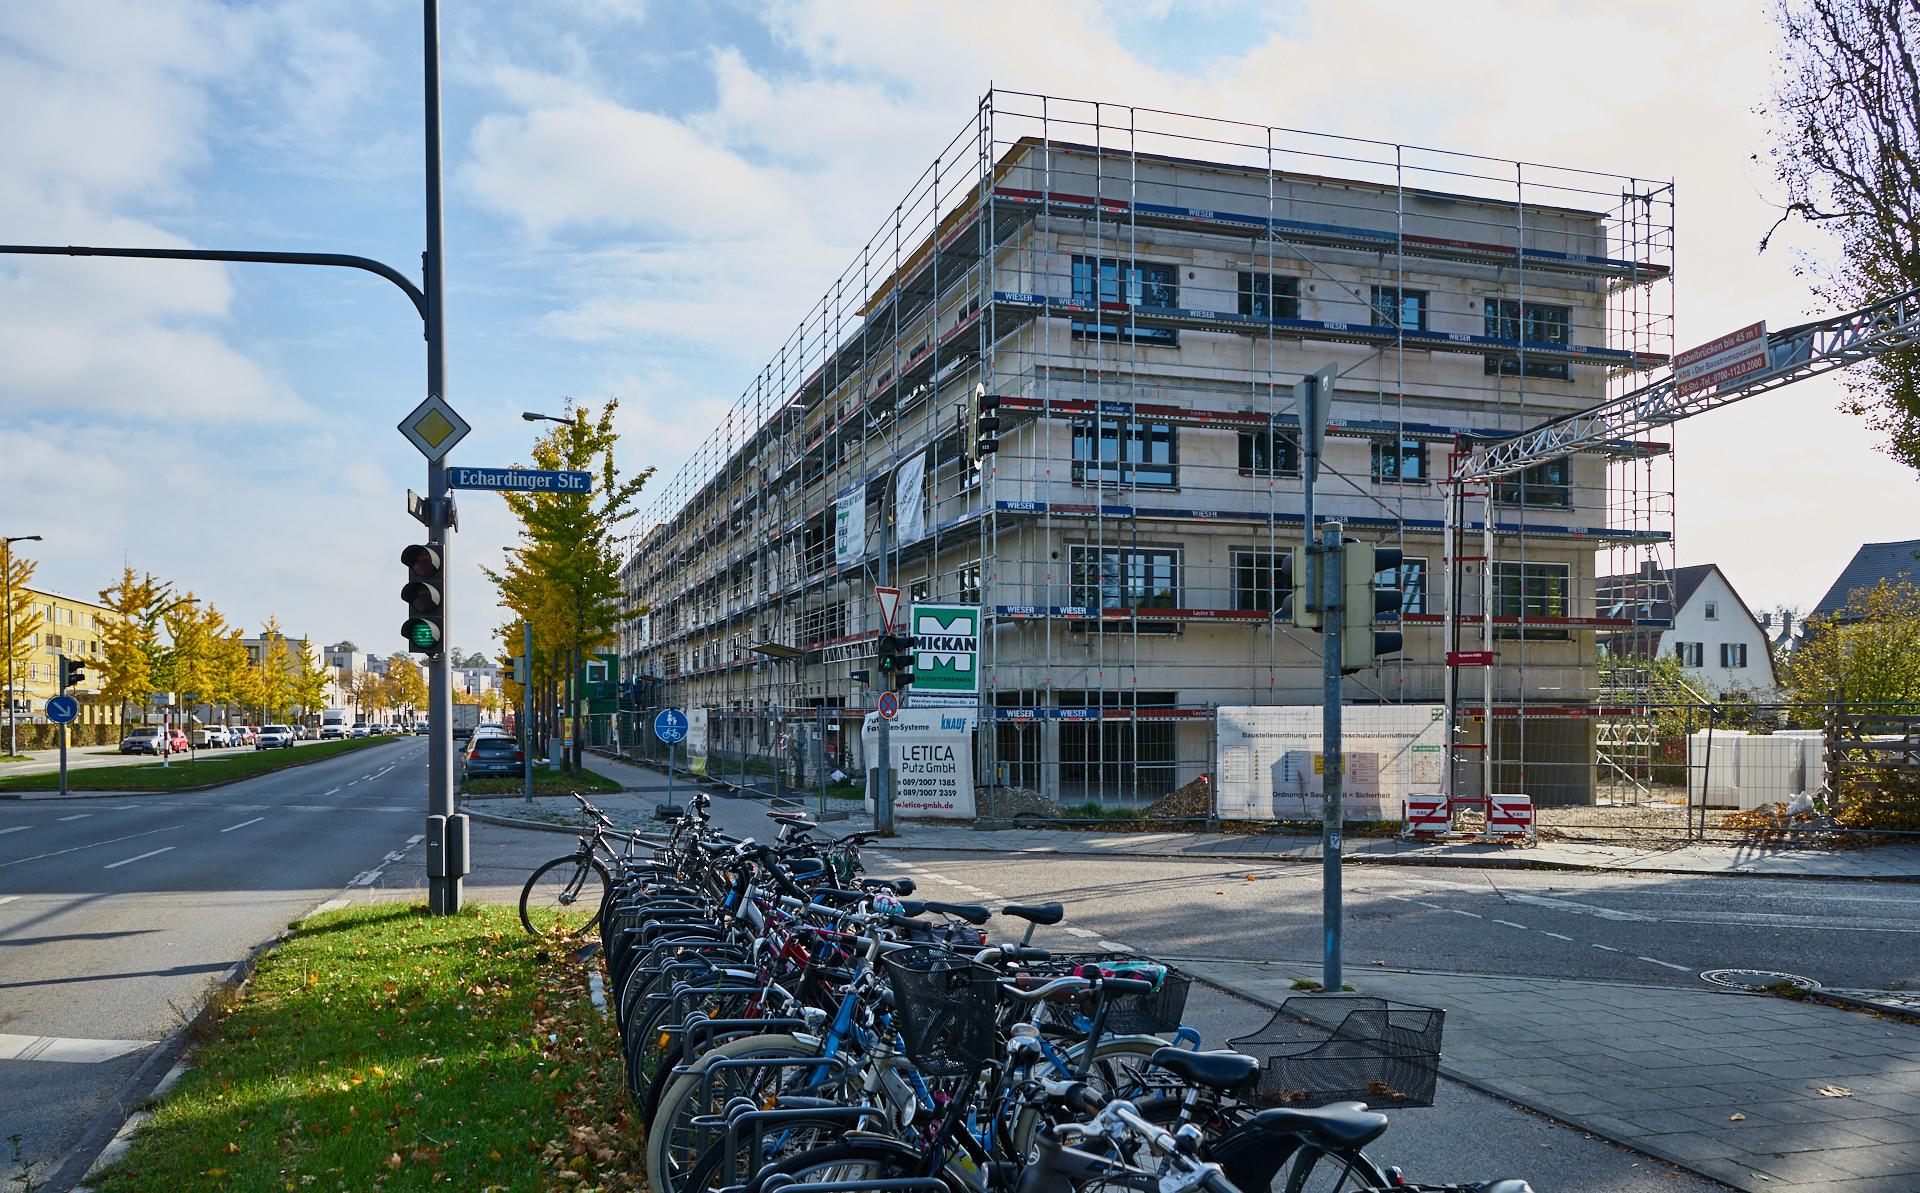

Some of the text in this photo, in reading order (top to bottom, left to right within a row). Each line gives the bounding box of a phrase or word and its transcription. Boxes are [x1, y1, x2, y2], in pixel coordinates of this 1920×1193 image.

[1188, 208, 1214, 219] WIESER
[1566, 252, 1587, 262] WIESER
[1004, 292, 1033, 302] WIESER
[1058, 297, 1085, 307] WIESER
[1189, 309, 1215, 319] WIESER
[1324, 321, 1348, 330] WIESER
[1448, 333, 1471, 342] WIESER
[1566, 344, 1588, 353] WIESER
[1678, 343, 1722, 366] Kabelbrücken
[1724, 338, 1735, 348] bis
[1736, 332, 1744, 342] 45
[1746, 330, 1753, 339] m
[1678, 370, 1690, 379] KBS
[1695, 366, 1704, 374] Der
[1706, 343, 1761, 370] Baustromspezialist
[459, 470, 584, 490] Echardinger Str.
[1006, 501, 1034, 510] WIESER
[1192, 510, 1218, 518] WIESER
[1006, 605, 1035, 614] WIESER
[1059, 606, 1087, 614] WIESER
[913, 636, 977, 651] MICKAN
[1006, 709, 1034, 718] WIESER
[1060, 709, 1087, 718] WIESER
[902, 745, 954, 761] LETICA
[902, 763, 956, 773] Putz GmbH
[903, 789, 937, 797] 089/2007
[894, 801, 953, 810] w.letica-gmbh.de
